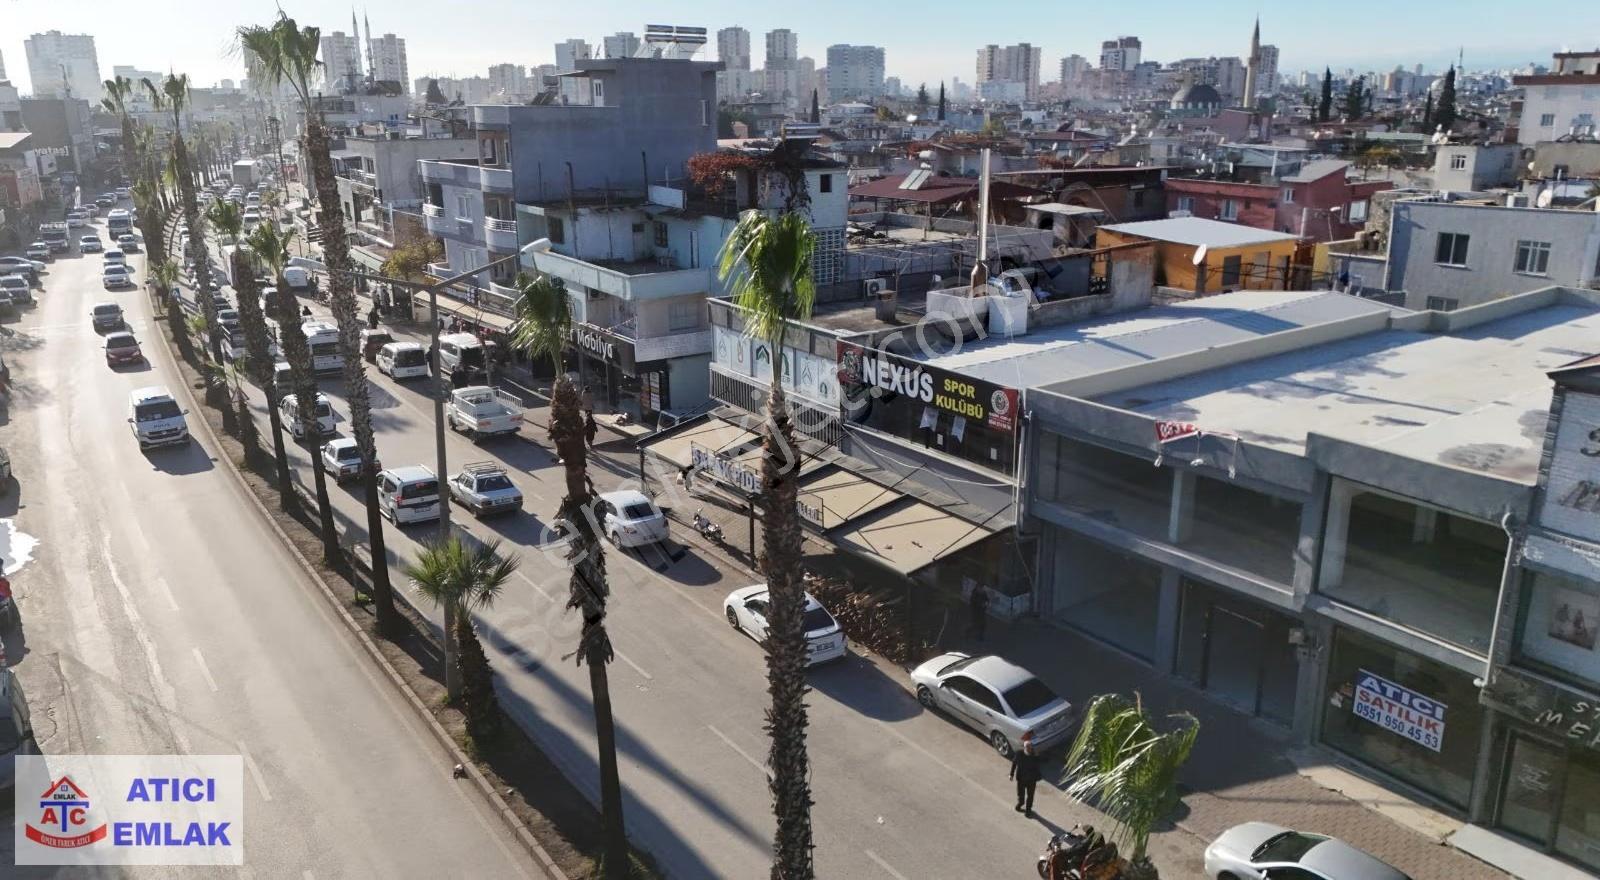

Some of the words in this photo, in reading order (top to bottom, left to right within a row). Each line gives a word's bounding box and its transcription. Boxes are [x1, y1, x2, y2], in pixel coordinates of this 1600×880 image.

[577, 328, 613, 361] Mobilya
[862, 356, 934, 403] NEXUS
[943, 378, 976, 399] SPOR
[935, 394, 984, 420] KULÜBÜ
[1358, 689, 1441, 734] SATILIK
[1360, 676, 1446, 720] ATICI
[1356, 702, 1382, 722] 0551
[1384, 714, 1405, 734] 950
[1407, 725, 1422, 741] 45
[1423, 732, 1440, 749] 53
